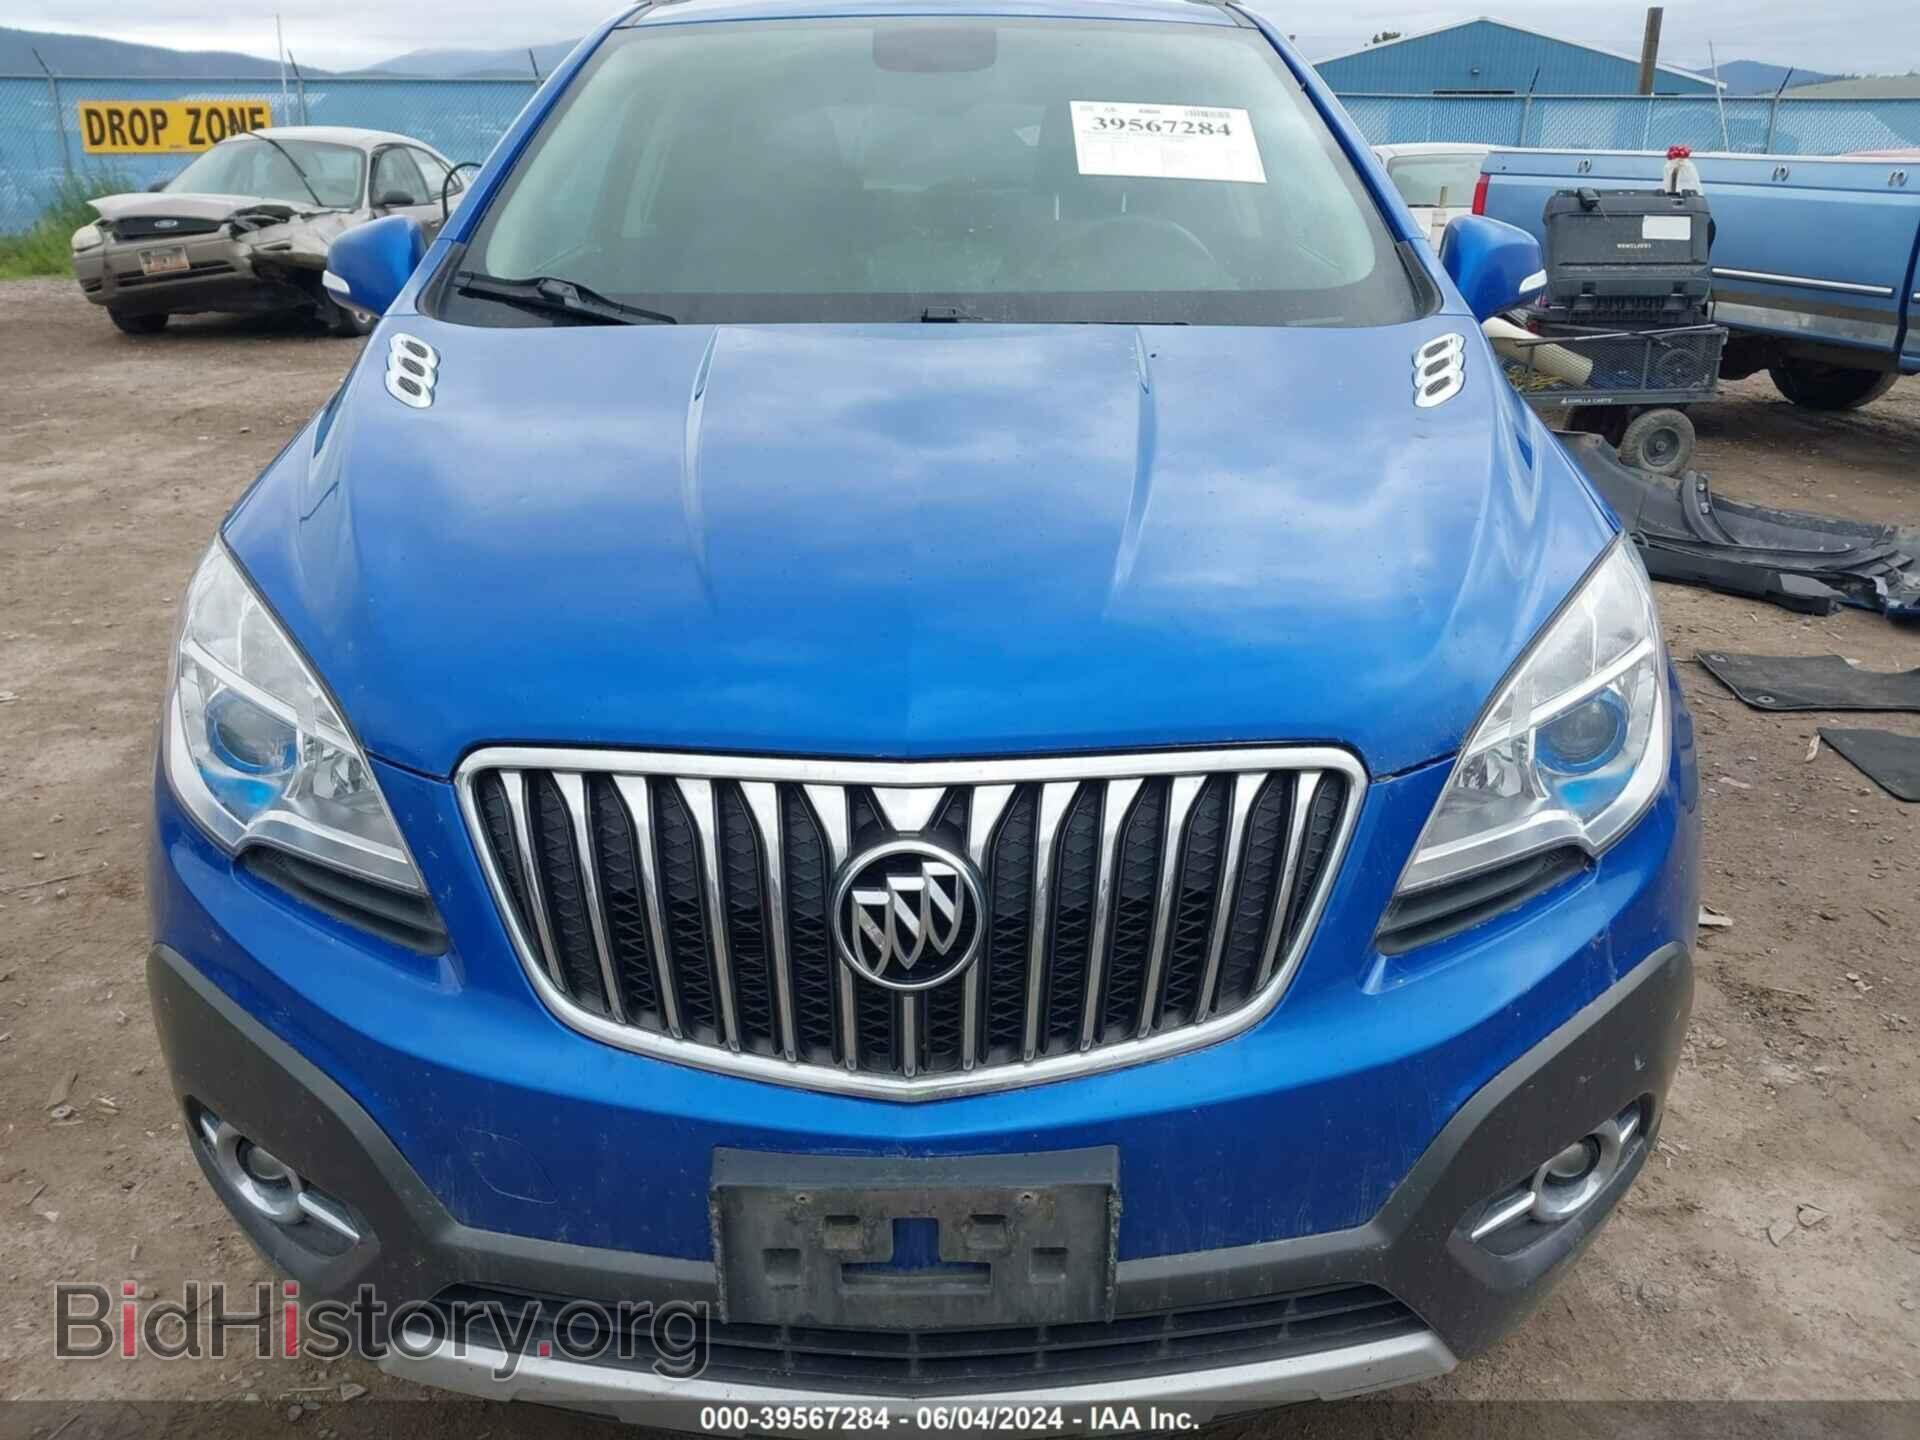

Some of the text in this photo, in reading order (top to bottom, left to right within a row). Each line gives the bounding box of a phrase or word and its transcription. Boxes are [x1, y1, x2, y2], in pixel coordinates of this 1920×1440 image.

[84, 107, 265, 146] DROP ZONE
[1091, 116, 1232, 136] 39567284
